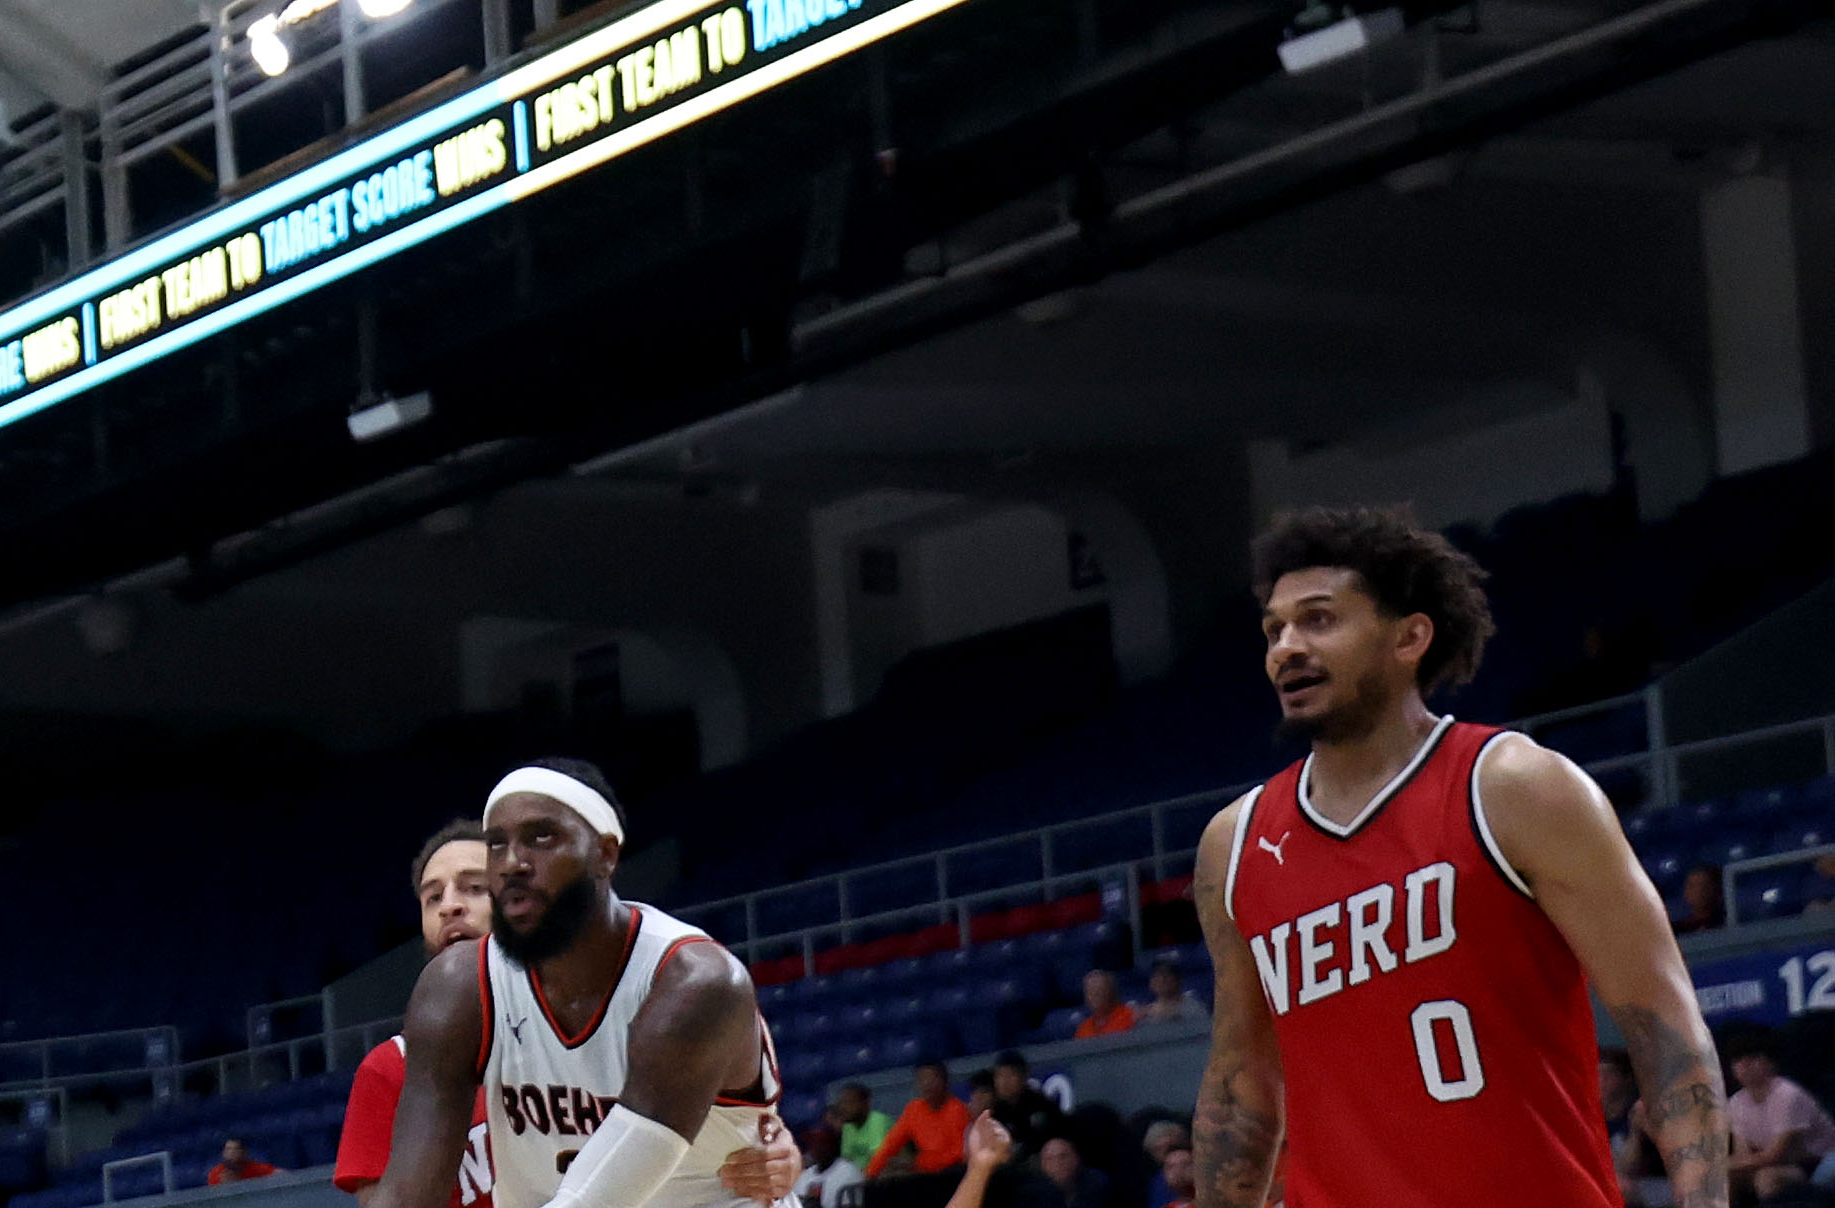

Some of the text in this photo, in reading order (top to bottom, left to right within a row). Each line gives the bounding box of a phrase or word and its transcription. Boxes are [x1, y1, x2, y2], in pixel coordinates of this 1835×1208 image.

[534, 64, 616, 152] FIRST
[616, 25, 702, 112] TEAM
[701, 6, 746, 74] TO
[99, 118, 507, 350] FIRST TEAM TO TARGET SCORE WINS
[22, 316, 81, 384] WINS
[1249, 861, 1458, 1016] NERD
[501, 1082, 620, 1137] BOEH
[1409, 998, 1487, 1103] 0
